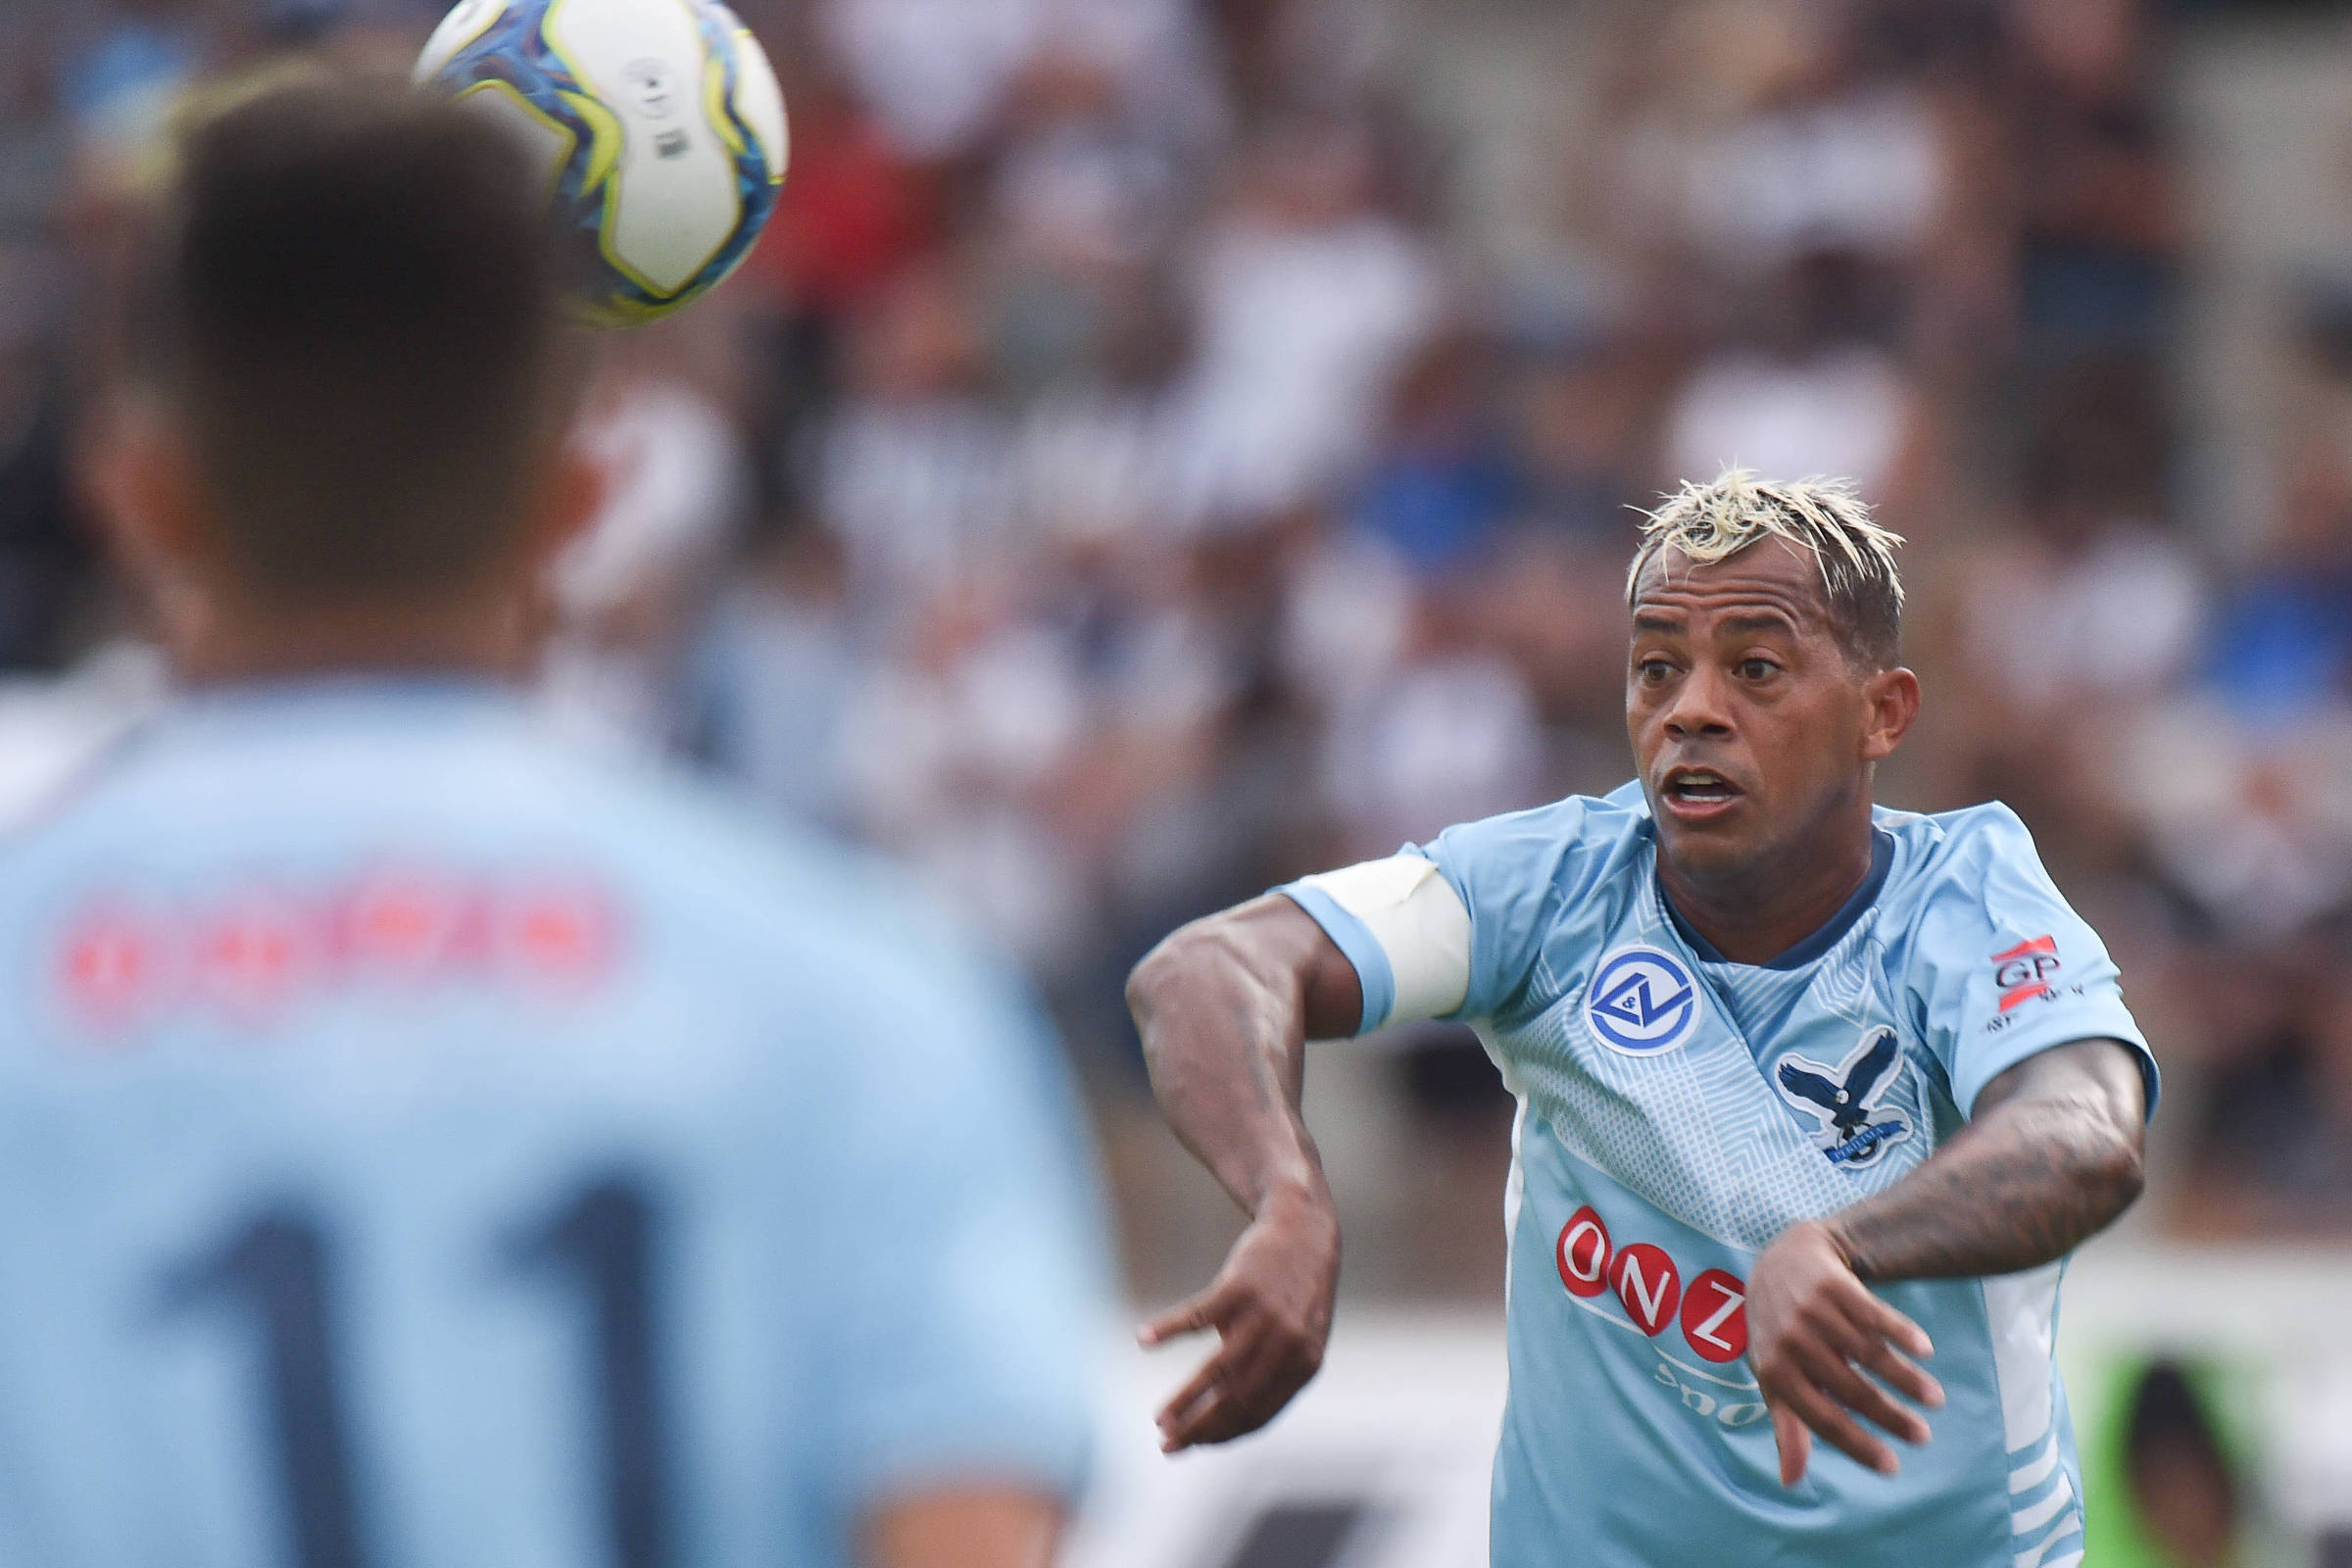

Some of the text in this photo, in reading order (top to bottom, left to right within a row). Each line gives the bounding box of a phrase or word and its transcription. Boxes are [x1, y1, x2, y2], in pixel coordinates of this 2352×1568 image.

[1995, 956, 2061, 989] GP
[1563, 1219, 1746, 1352] ONZ
[137, 1166, 676, 1568] 11
